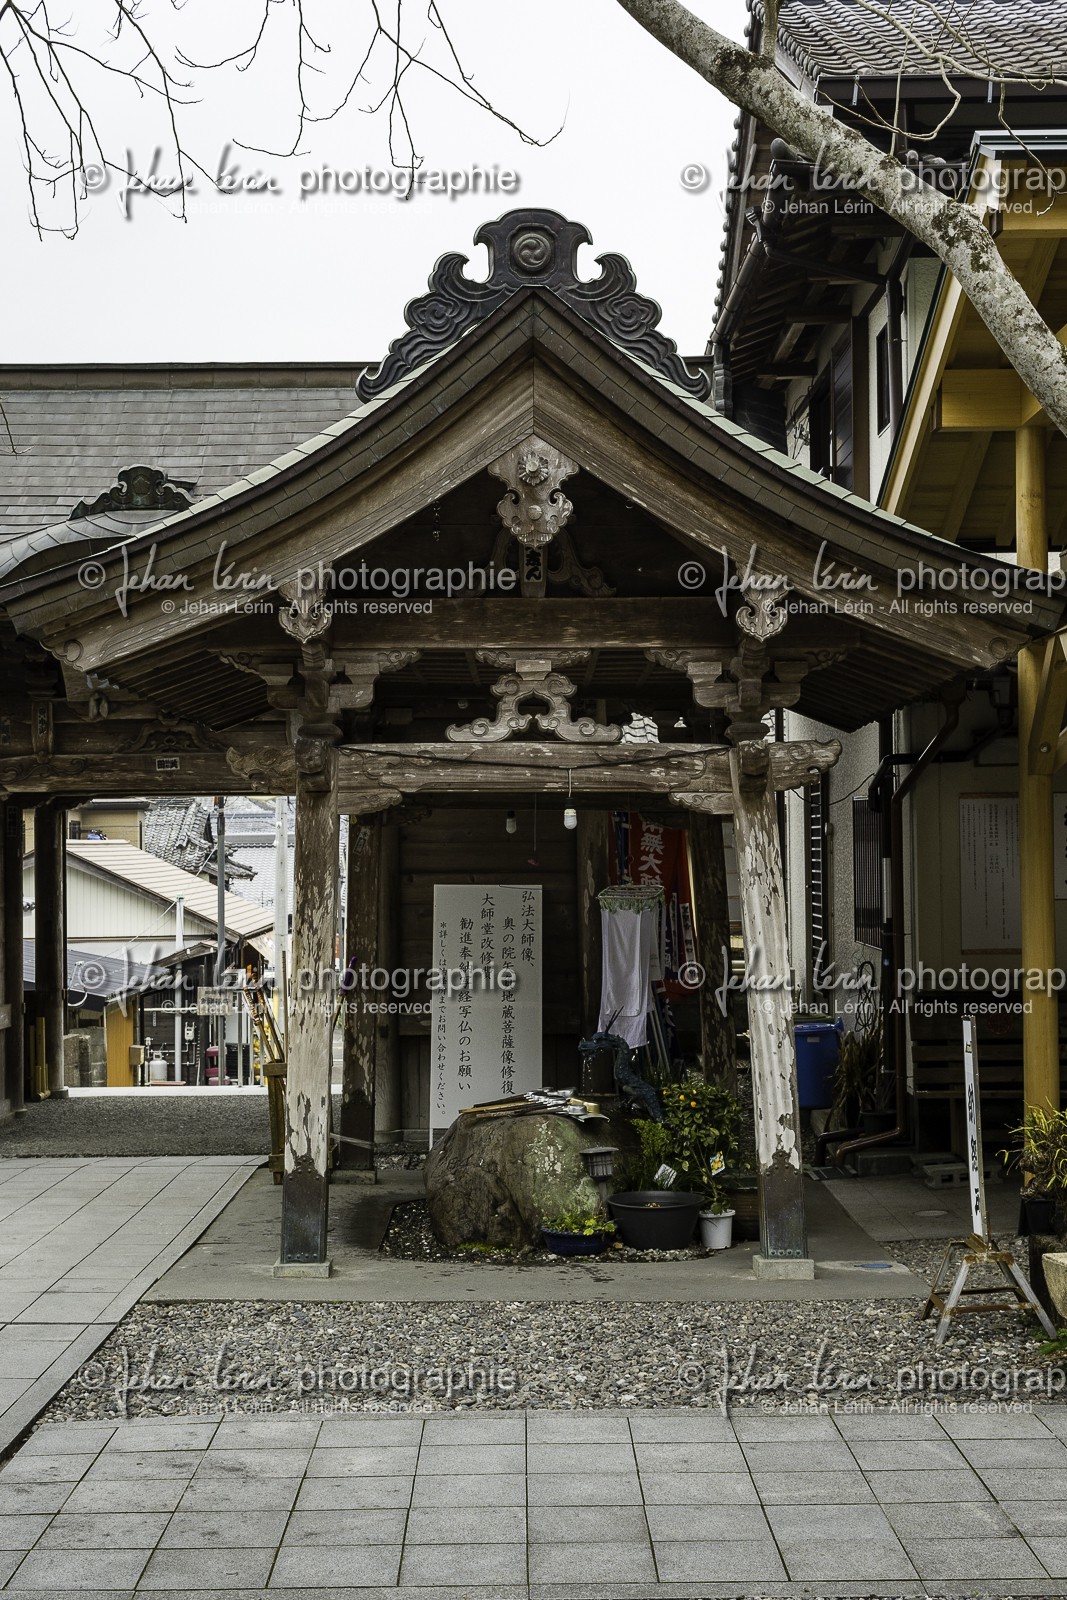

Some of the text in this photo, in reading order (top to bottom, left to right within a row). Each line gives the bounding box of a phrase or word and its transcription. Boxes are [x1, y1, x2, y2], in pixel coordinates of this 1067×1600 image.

[521, 890, 536, 967] 弘法大師像、
